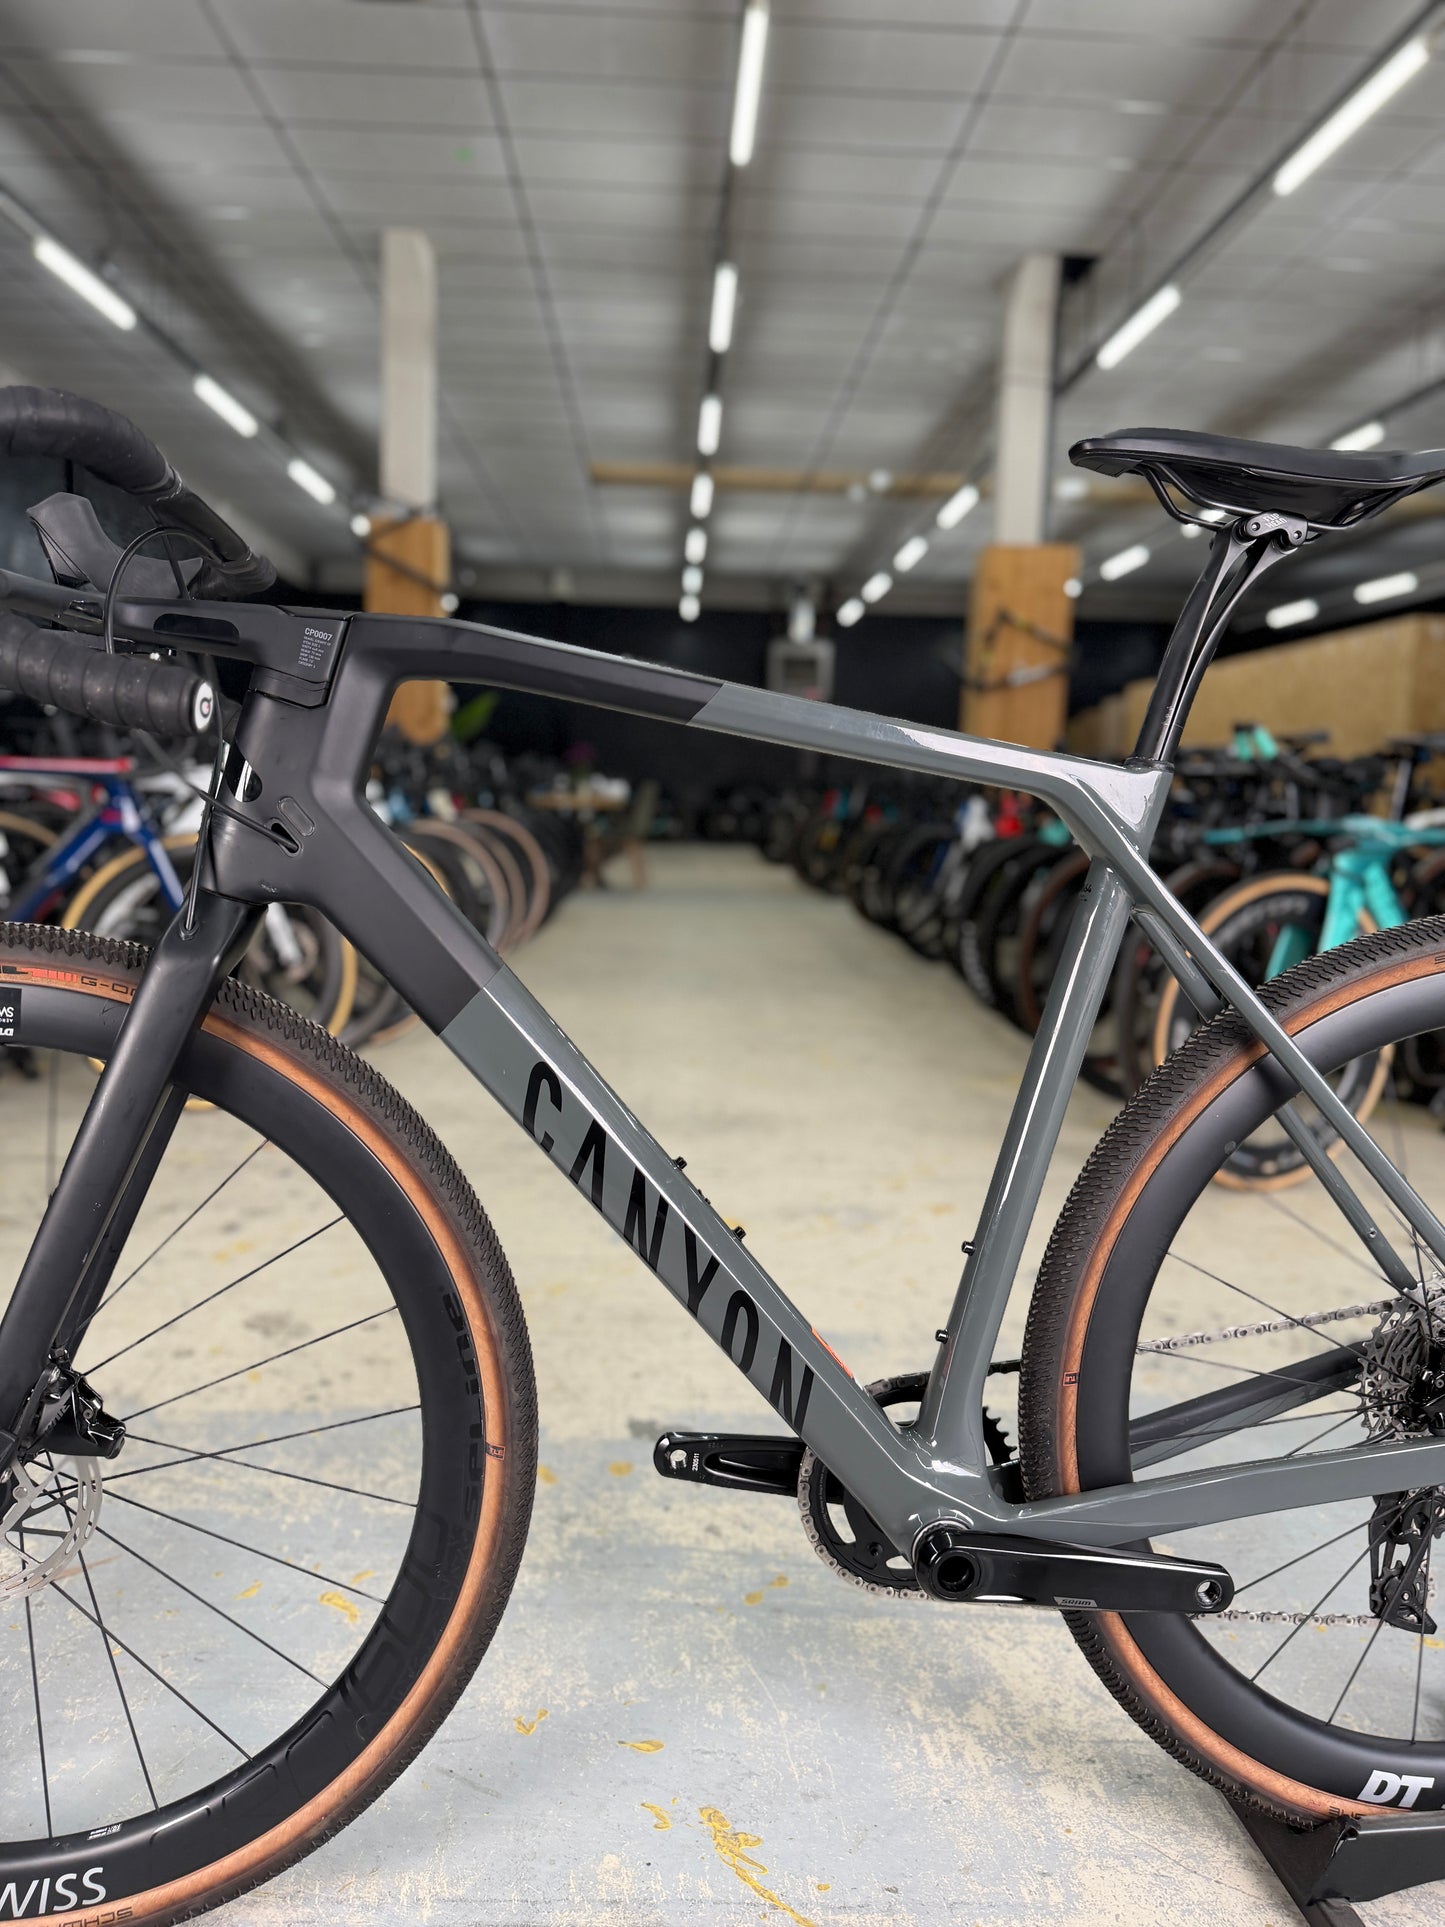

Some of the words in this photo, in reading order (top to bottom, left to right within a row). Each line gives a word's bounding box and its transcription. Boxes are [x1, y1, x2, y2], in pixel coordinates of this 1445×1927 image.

[305, 627, 333, 641] CP0007
[523, 1061, 815, 1434] CANYON
[1356, 1769, 1435, 1808] DT
